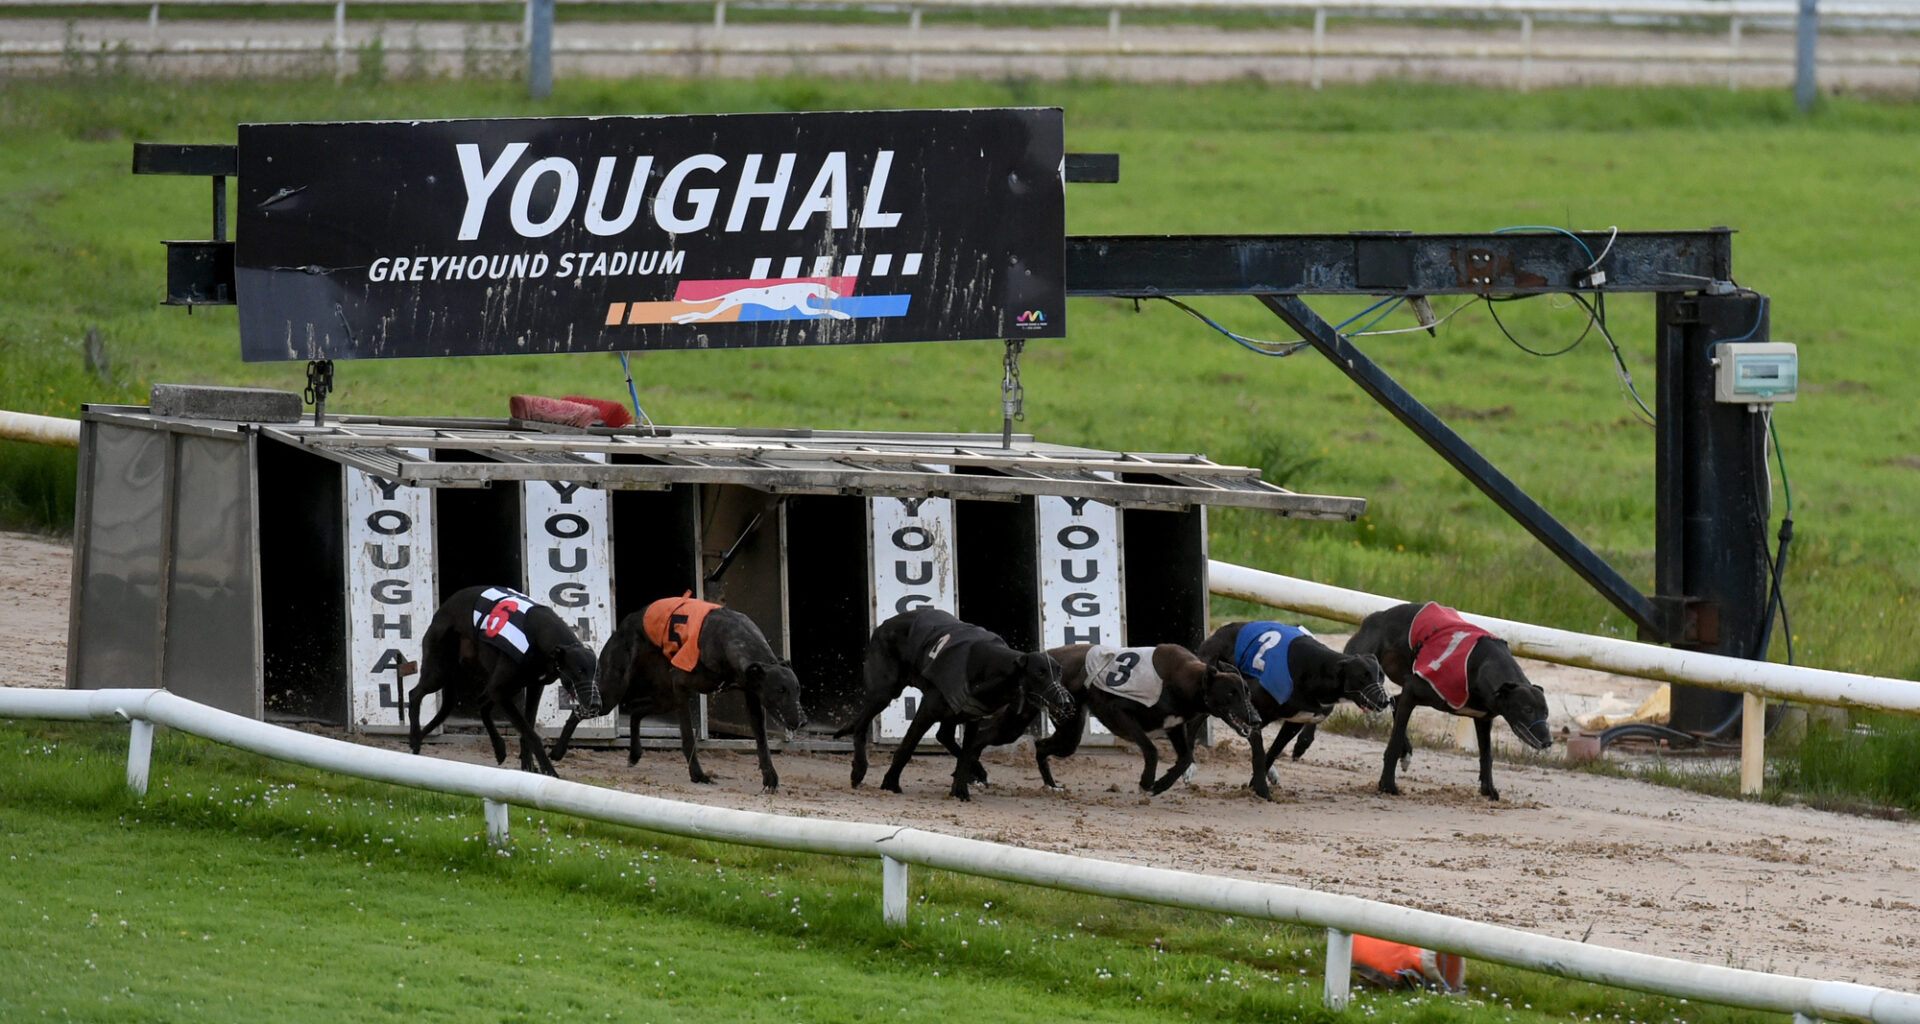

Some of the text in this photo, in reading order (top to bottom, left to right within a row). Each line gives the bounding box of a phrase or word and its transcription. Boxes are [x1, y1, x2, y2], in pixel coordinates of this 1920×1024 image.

[456, 142, 903, 241] YOUGHAL
[368, 250, 685, 283] GREYHOUND STADIUM
[366, 475, 413, 708] YOUGHAL
[485, 600, 519, 638] 6
[668, 614, 689, 657] 5
[1105, 652, 1141, 687] 3
[1252, 630, 1282, 671] 2
[1428, 631, 1471, 671] 1
